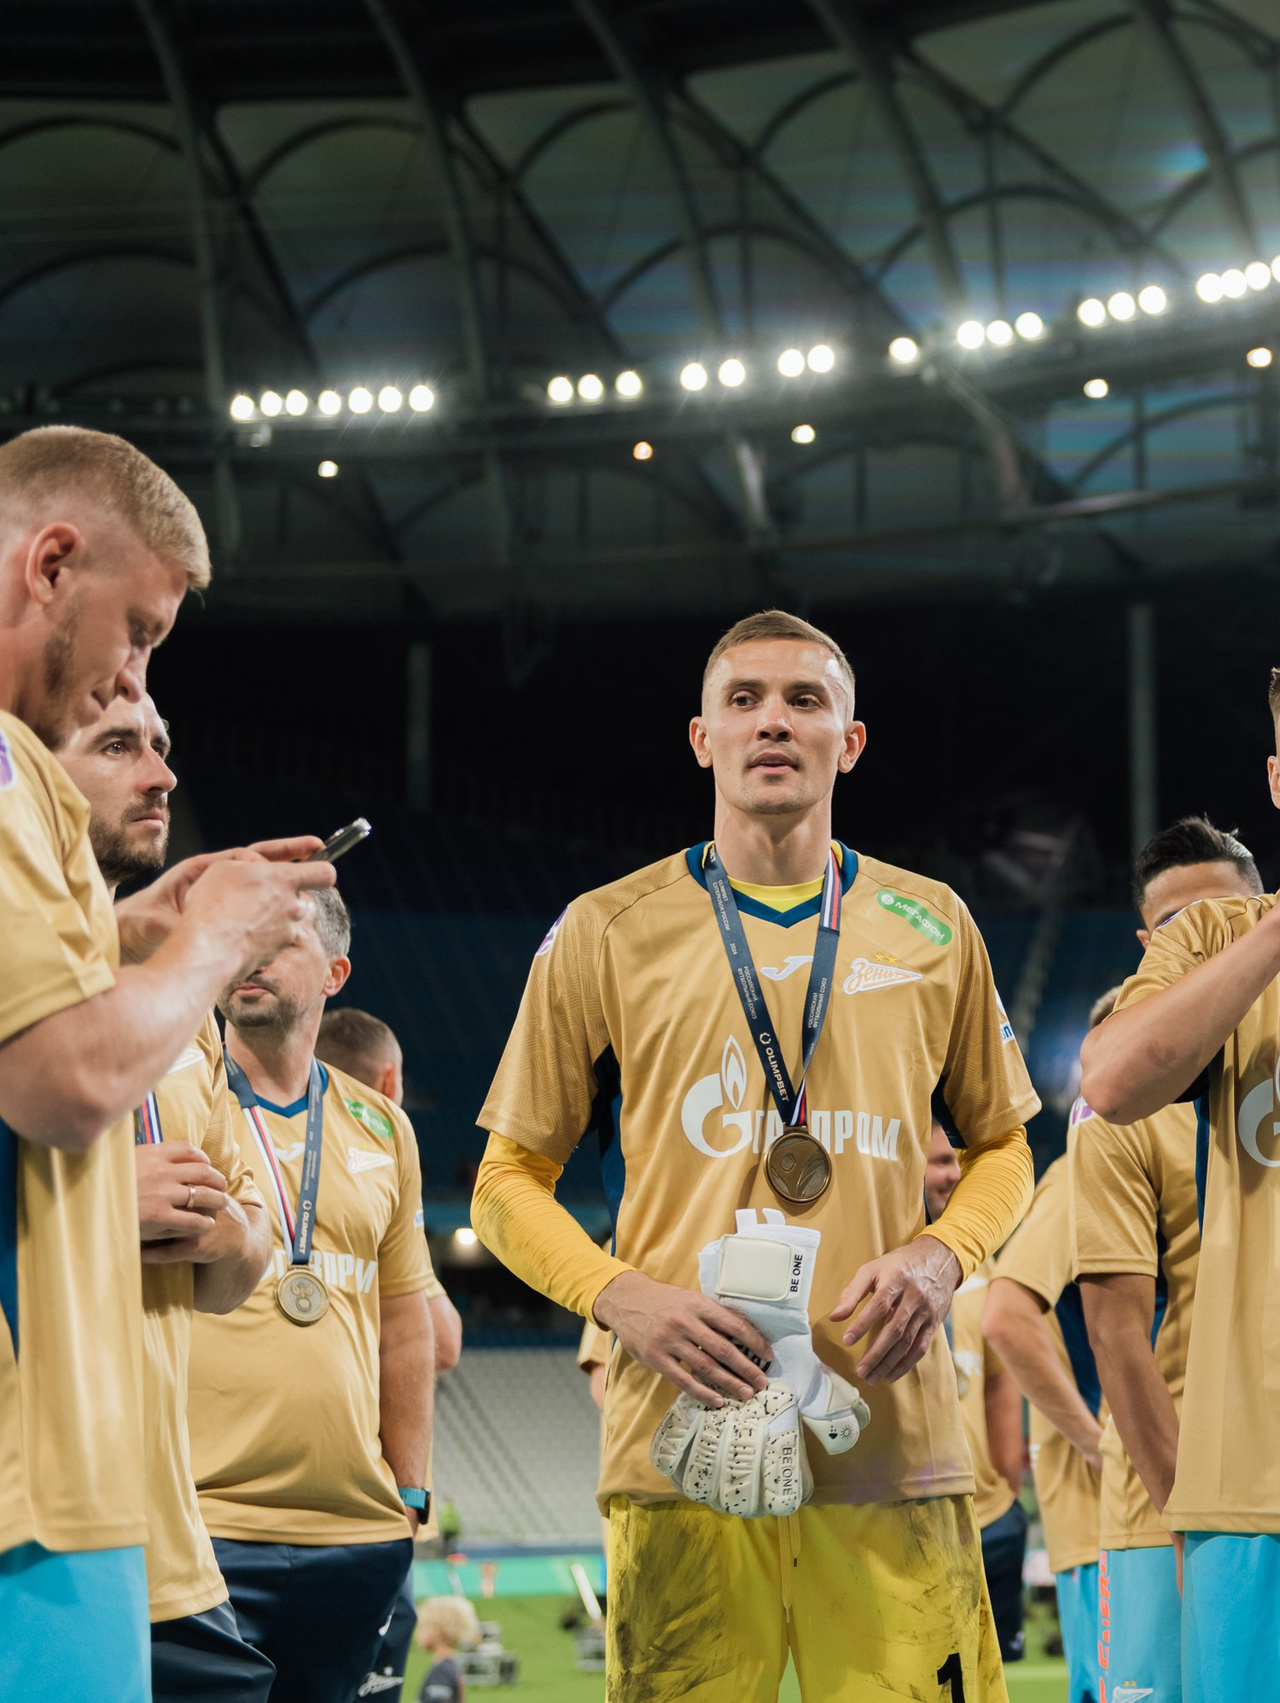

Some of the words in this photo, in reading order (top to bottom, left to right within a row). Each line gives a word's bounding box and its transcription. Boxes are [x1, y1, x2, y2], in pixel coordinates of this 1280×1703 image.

[894, 901, 945, 940] МЕГАФОН
[765, 1047, 789, 1102] OLIMPBET
[752, 1109, 902, 1162] ГАПРОМ
[299, 1211, 310, 1254] OLIMPBET
[792, 1254, 803, 1277] ONE
[789, 1278, 800, 1293] BE
[782, 1446, 793, 1465] BE
[782, 1467, 793, 1496] ONE
